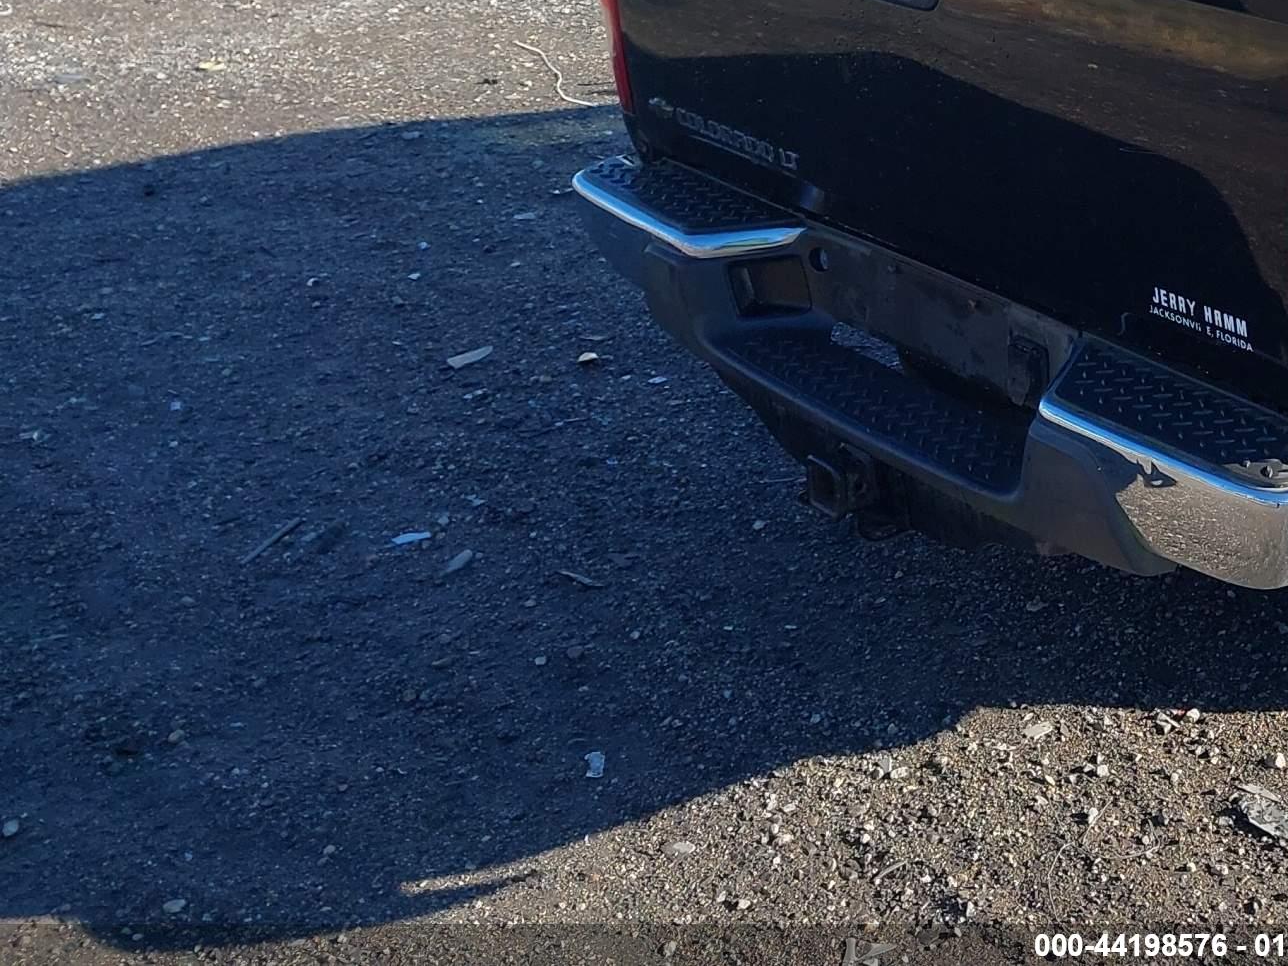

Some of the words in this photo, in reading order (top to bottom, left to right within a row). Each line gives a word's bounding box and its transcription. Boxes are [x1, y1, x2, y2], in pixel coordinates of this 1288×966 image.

[675, 107, 775, 163] COLORADO
[1152, 287, 1196, 317] JERRY
[1203, 305, 1248, 338] HAMM
[1216, 330, 1255, 353] FLORIDA
